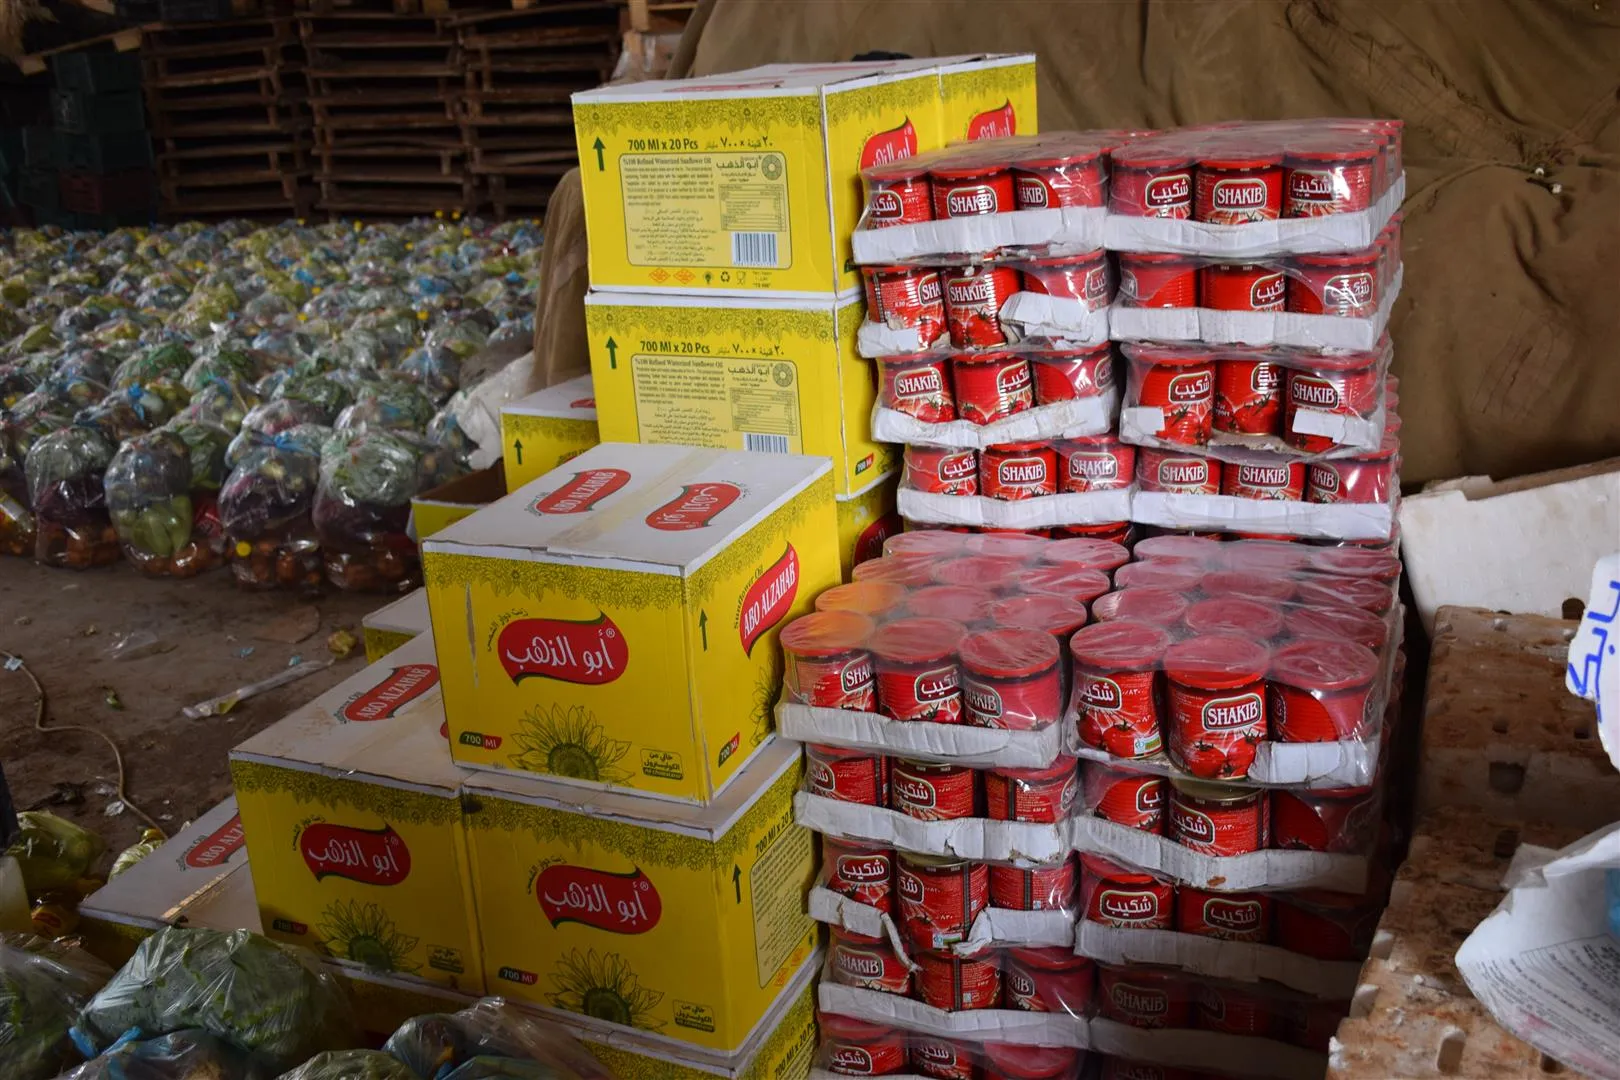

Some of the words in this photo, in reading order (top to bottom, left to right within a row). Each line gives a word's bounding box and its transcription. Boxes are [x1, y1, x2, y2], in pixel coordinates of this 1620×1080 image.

[628, 139, 646, 151] 700
[669, 138, 681, 150] 20
[683, 138, 699, 150] Pcs
[1151, 178, 1189, 204] شكيب
[1217, 187, 1263, 205] SHAKIB
[950, 283, 989, 301] SHAKIB
[640, 340, 658, 353] 700
[681, 342, 693, 354] 20
[695, 342, 711, 354] Pcs
[898, 373, 940, 394] SHAKIB
[1174, 375, 1210, 398] شكيب
[1293, 382, 1336, 405] SHAKIB
[1002, 464, 1044, 482] SHAKIB
[1072, 459, 1114, 476] SHAKIB
[1161, 465, 1205, 481] SHAKIB
[1242, 466, 1286, 484] SHAKIB
[744, 601, 760, 639] ABO
[761, 561, 796, 620] ALZAHAB
[506, 634, 578, 671] الذهب
[356, 701, 388, 719] ABO
[1206, 701, 1259, 726] SHAKIB
[464, 733, 482, 745] 700
[308, 838, 369, 868] الذهب
[842, 858, 884, 881] شكيب
[543, 881, 612, 915] الذهب
[1106, 895, 1152, 914] شكيب
[1210, 905, 1257, 925] شكيب
[503, 969, 520, 980] 700
[1114, 989, 1164, 1012] SHAKIB
